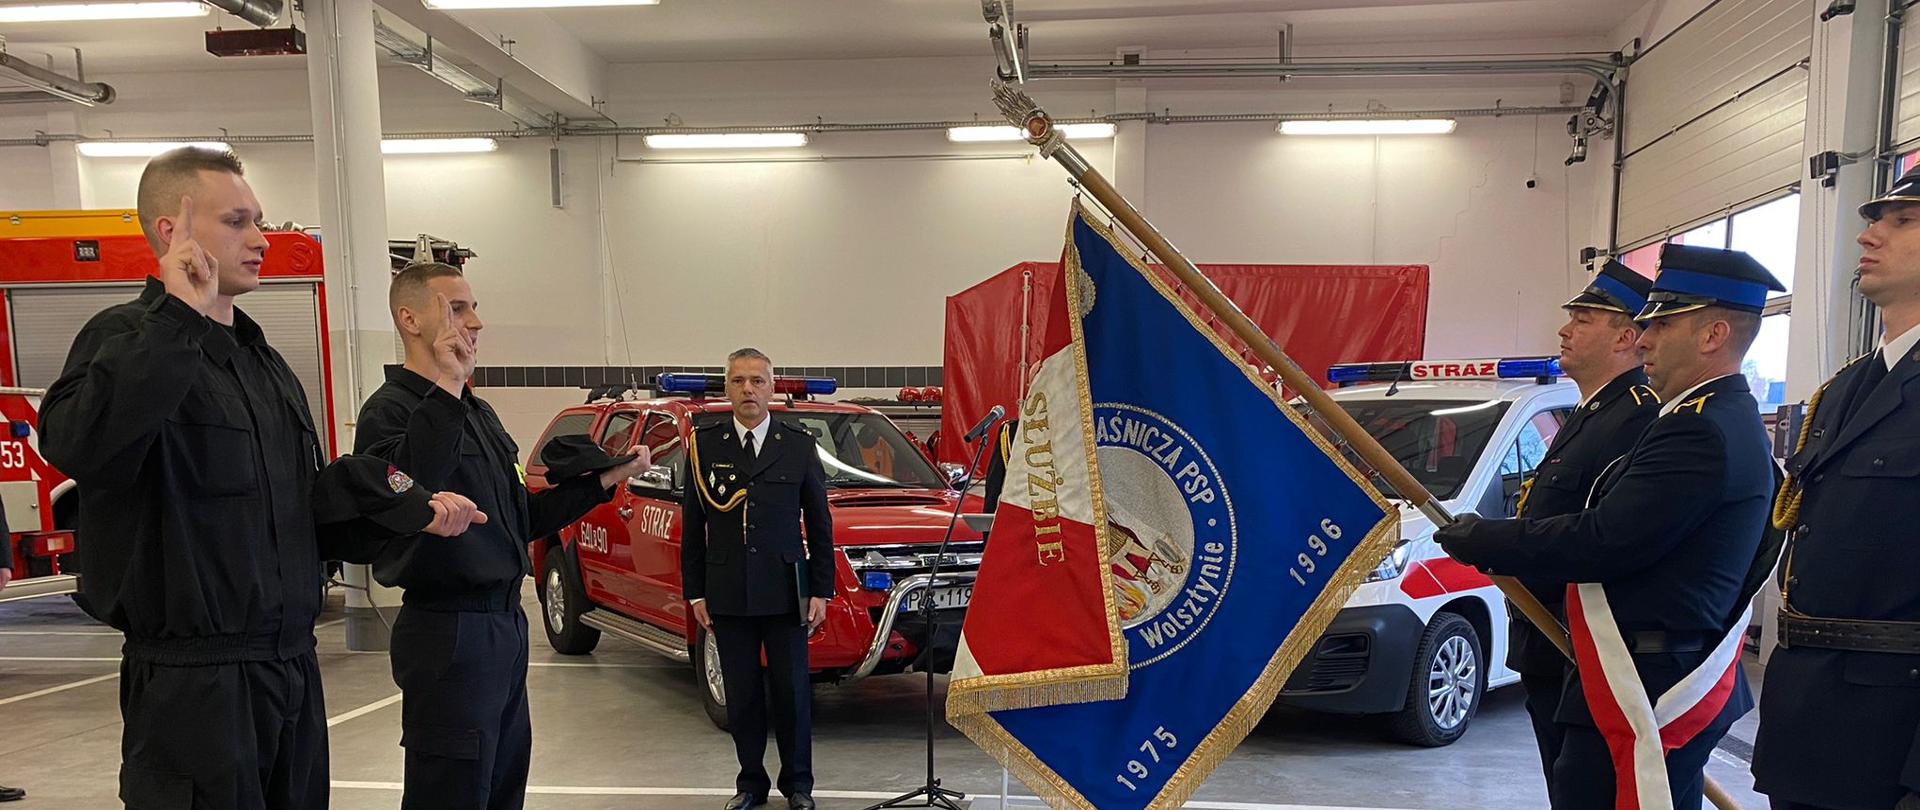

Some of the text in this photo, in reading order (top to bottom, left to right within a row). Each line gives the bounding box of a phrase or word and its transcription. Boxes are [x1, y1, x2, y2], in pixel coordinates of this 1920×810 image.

[0, 441, 25, 468] 53
[1023, 391, 1065, 566] SŁUŻBIE
[1096, 411, 1215, 504] AŚNICZA PSP
[1289, 518, 1342, 586] 1996
[1139, 542, 1225, 649] Wolsztynie
[1116, 726, 1177, 791] 1975
